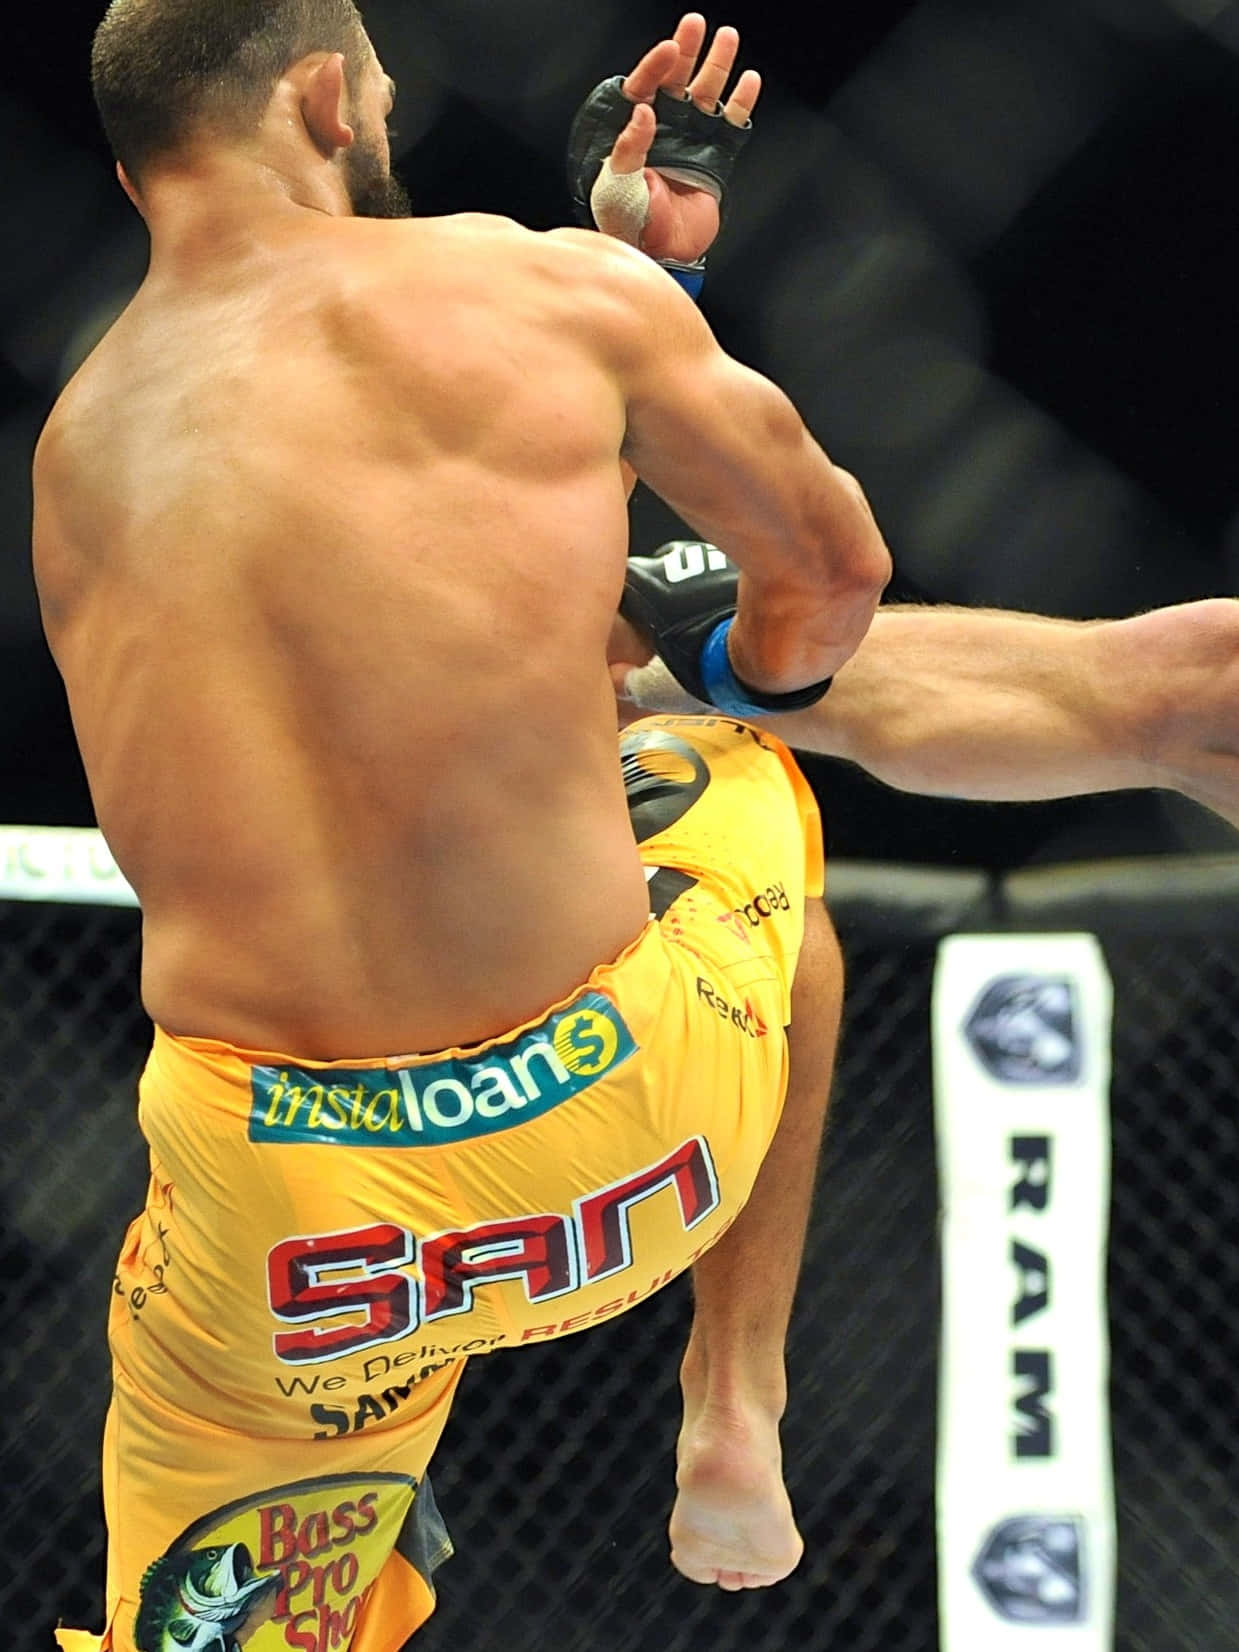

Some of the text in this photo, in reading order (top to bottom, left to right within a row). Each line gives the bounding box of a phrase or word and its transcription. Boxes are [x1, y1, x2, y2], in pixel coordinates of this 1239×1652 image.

[266, 1134, 722, 1367] SAN
[1009, 1131, 1058, 1460] RAM
[274, 1374, 347, 1398] We
[255, 1492, 380, 1570] Bass
[270, 1551, 360, 1623] Pro
